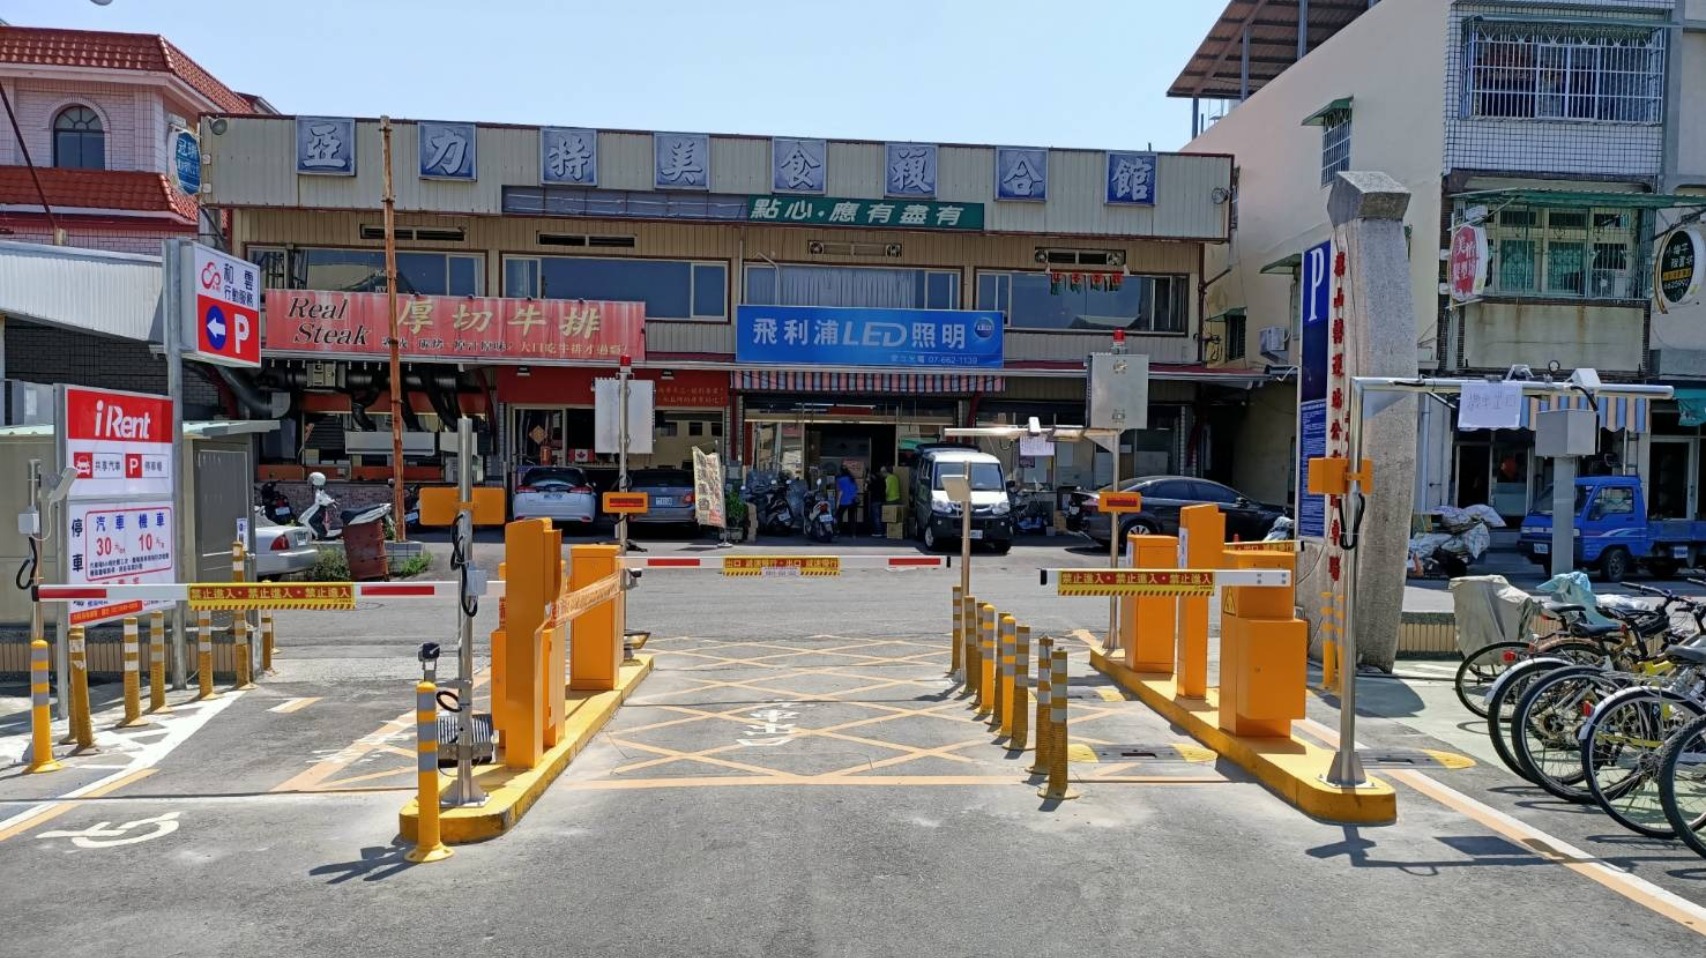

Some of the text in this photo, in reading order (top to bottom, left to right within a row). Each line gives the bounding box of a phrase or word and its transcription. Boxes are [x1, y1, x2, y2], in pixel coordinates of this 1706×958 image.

[1308, 247, 1325, 322] P
[286, 297, 348, 320] Real
[399, 299, 601, 340] 厚切牛排
[234, 313, 250, 354] P
[294, 321, 372, 345] Steak
[753, 317, 966, 349] 飛利浦LED照明
[95, 461, 120, 472] 共享汽車
[96, 533, 152, 556] 30 10
